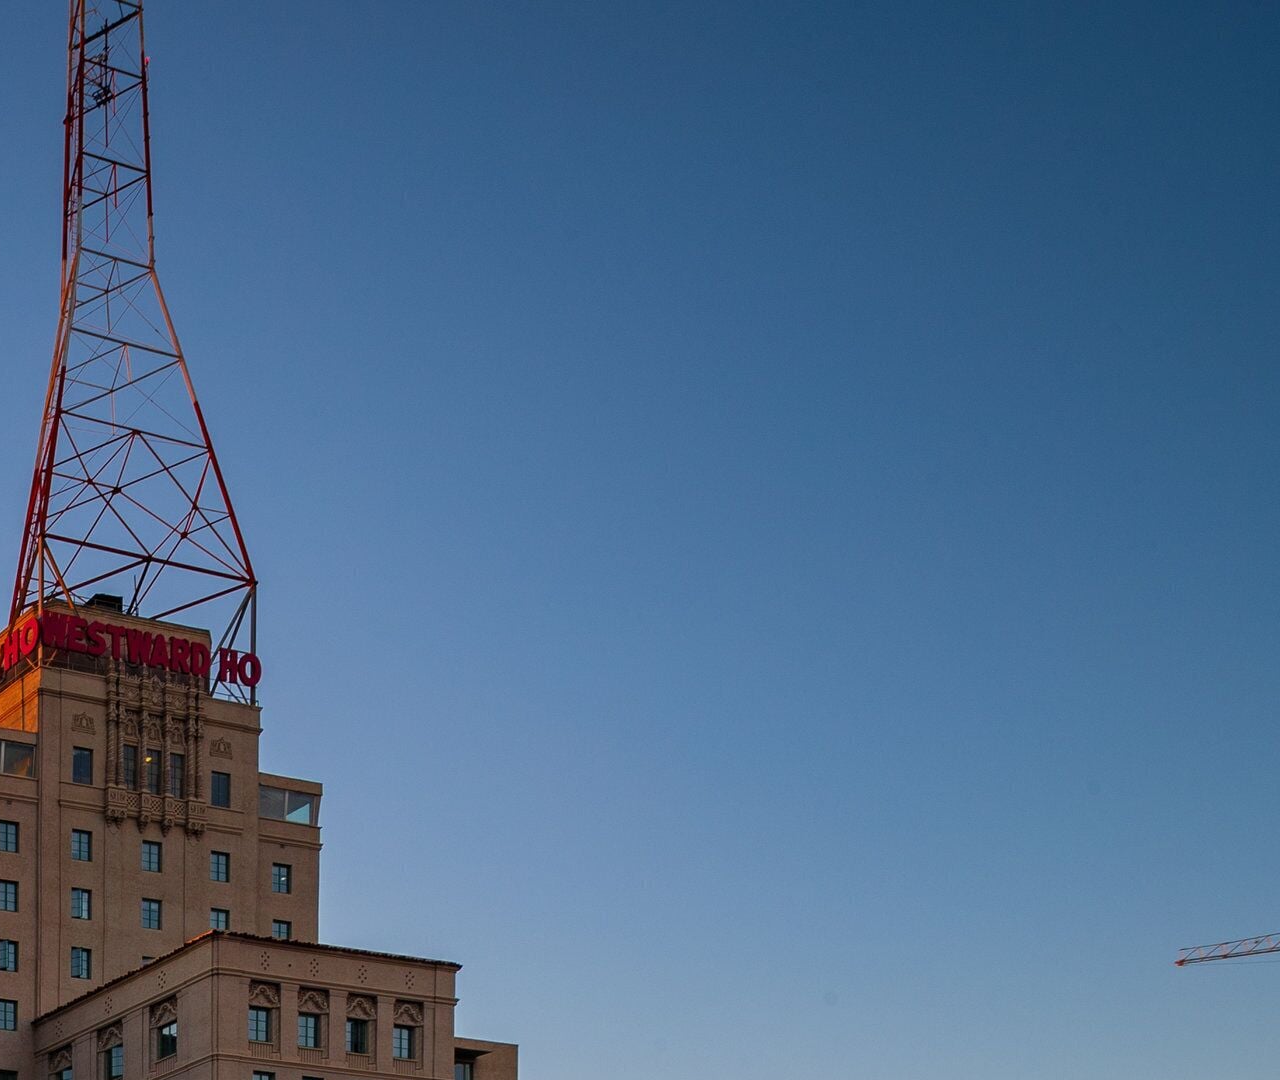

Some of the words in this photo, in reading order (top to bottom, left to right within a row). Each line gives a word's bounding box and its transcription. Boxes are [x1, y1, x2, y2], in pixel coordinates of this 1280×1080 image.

[2, 617, 40, 672] HO
[42, 612, 210, 678] WESTWARD
[218, 648, 262, 686] HO
